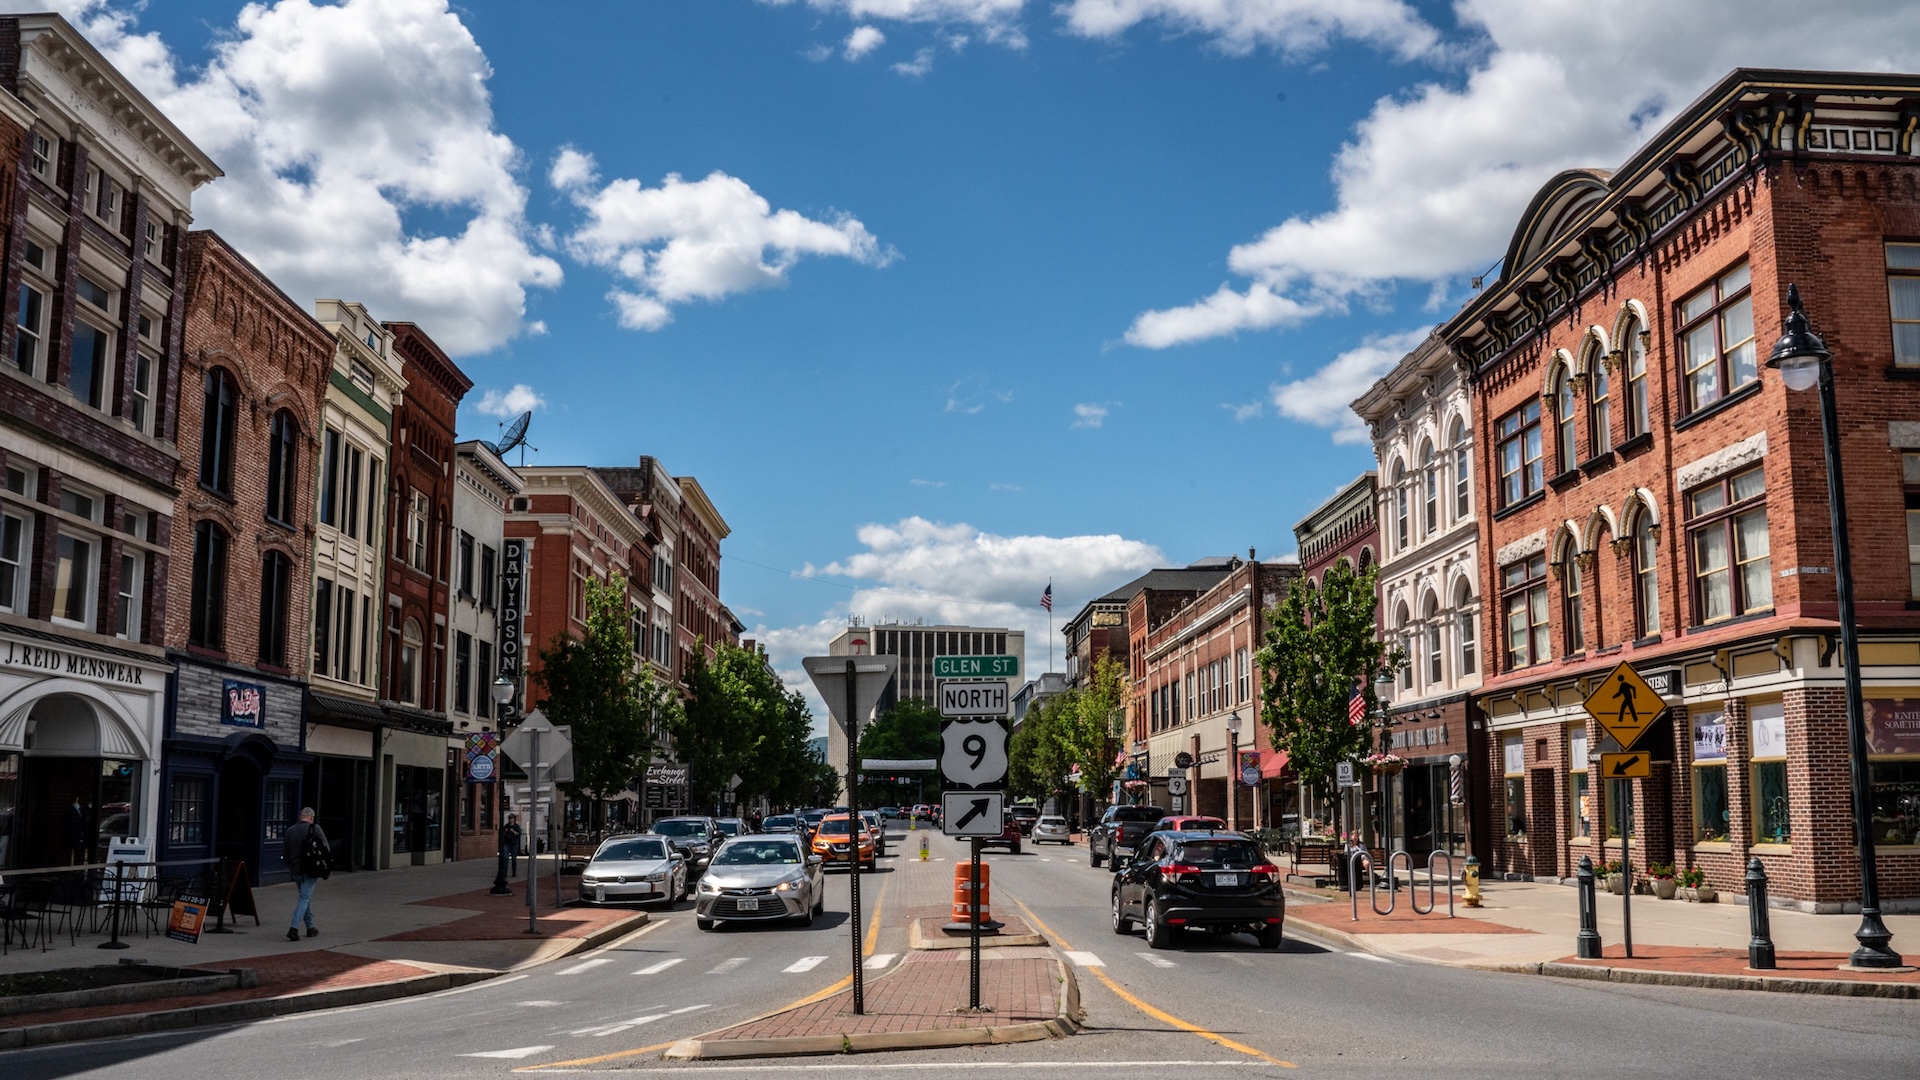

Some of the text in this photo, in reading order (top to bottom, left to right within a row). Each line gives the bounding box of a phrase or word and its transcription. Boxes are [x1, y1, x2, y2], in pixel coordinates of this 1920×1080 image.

[502, 545, 520, 671] DAVIDSON
[5, 641, 142, 684] J. REID MENSWEAR
[940, 659, 1010, 673] GLEN ST
[1644, 675, 1668, 689] STERN
[945, 689, 1004, 709] NORTH
[962, 734, 986, 771] 9
[646, 766, 686, 779] Exchange
[1340, 765, 1349, 774] 10
[658, 775, 686, 785] Street
[1173, 780, 1181, 791] 9
